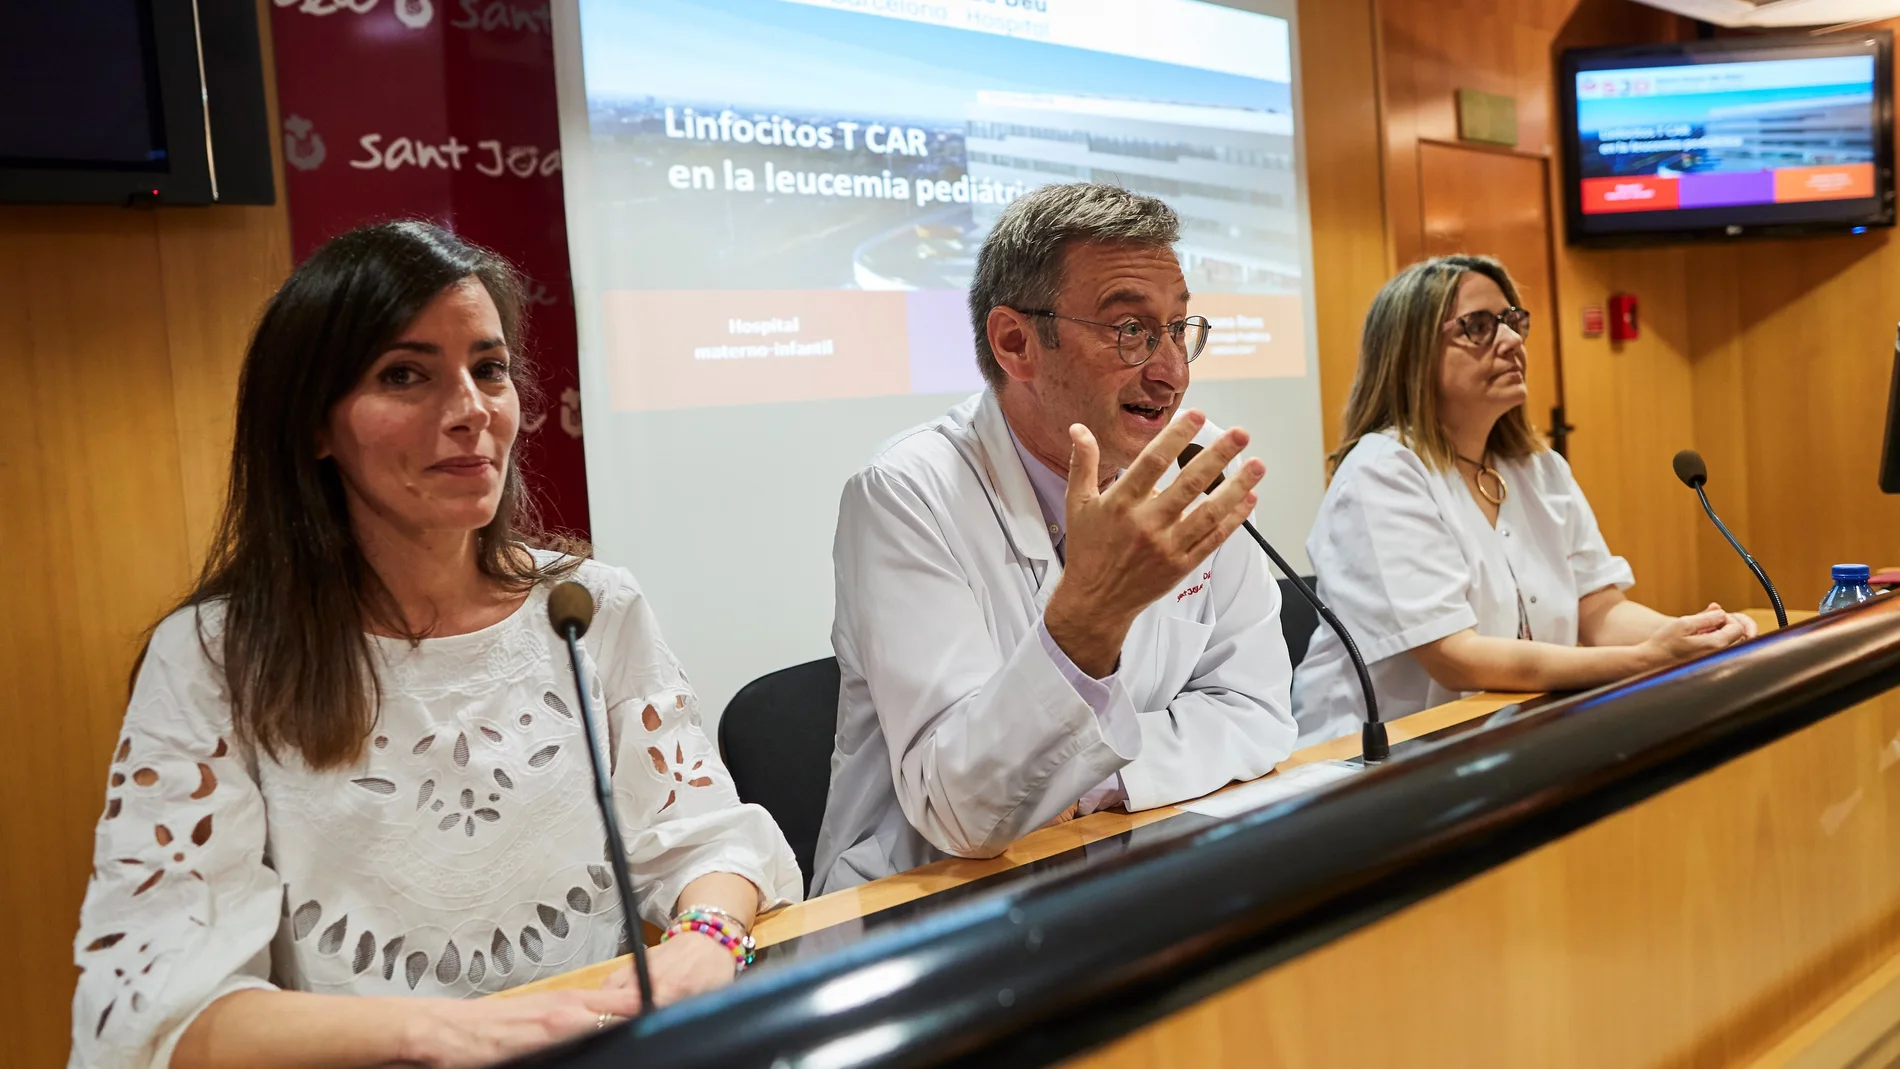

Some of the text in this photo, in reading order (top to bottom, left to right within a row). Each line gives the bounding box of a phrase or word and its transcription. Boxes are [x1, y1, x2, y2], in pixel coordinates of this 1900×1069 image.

[664, 106, 928, 157] Linfocitos T CAR
[668, 163, 715, 190] en
[724, 158, 755, 193] la
[765, 161, 909, 200] leucemia
[728, 316, 800, 336] Hospital
